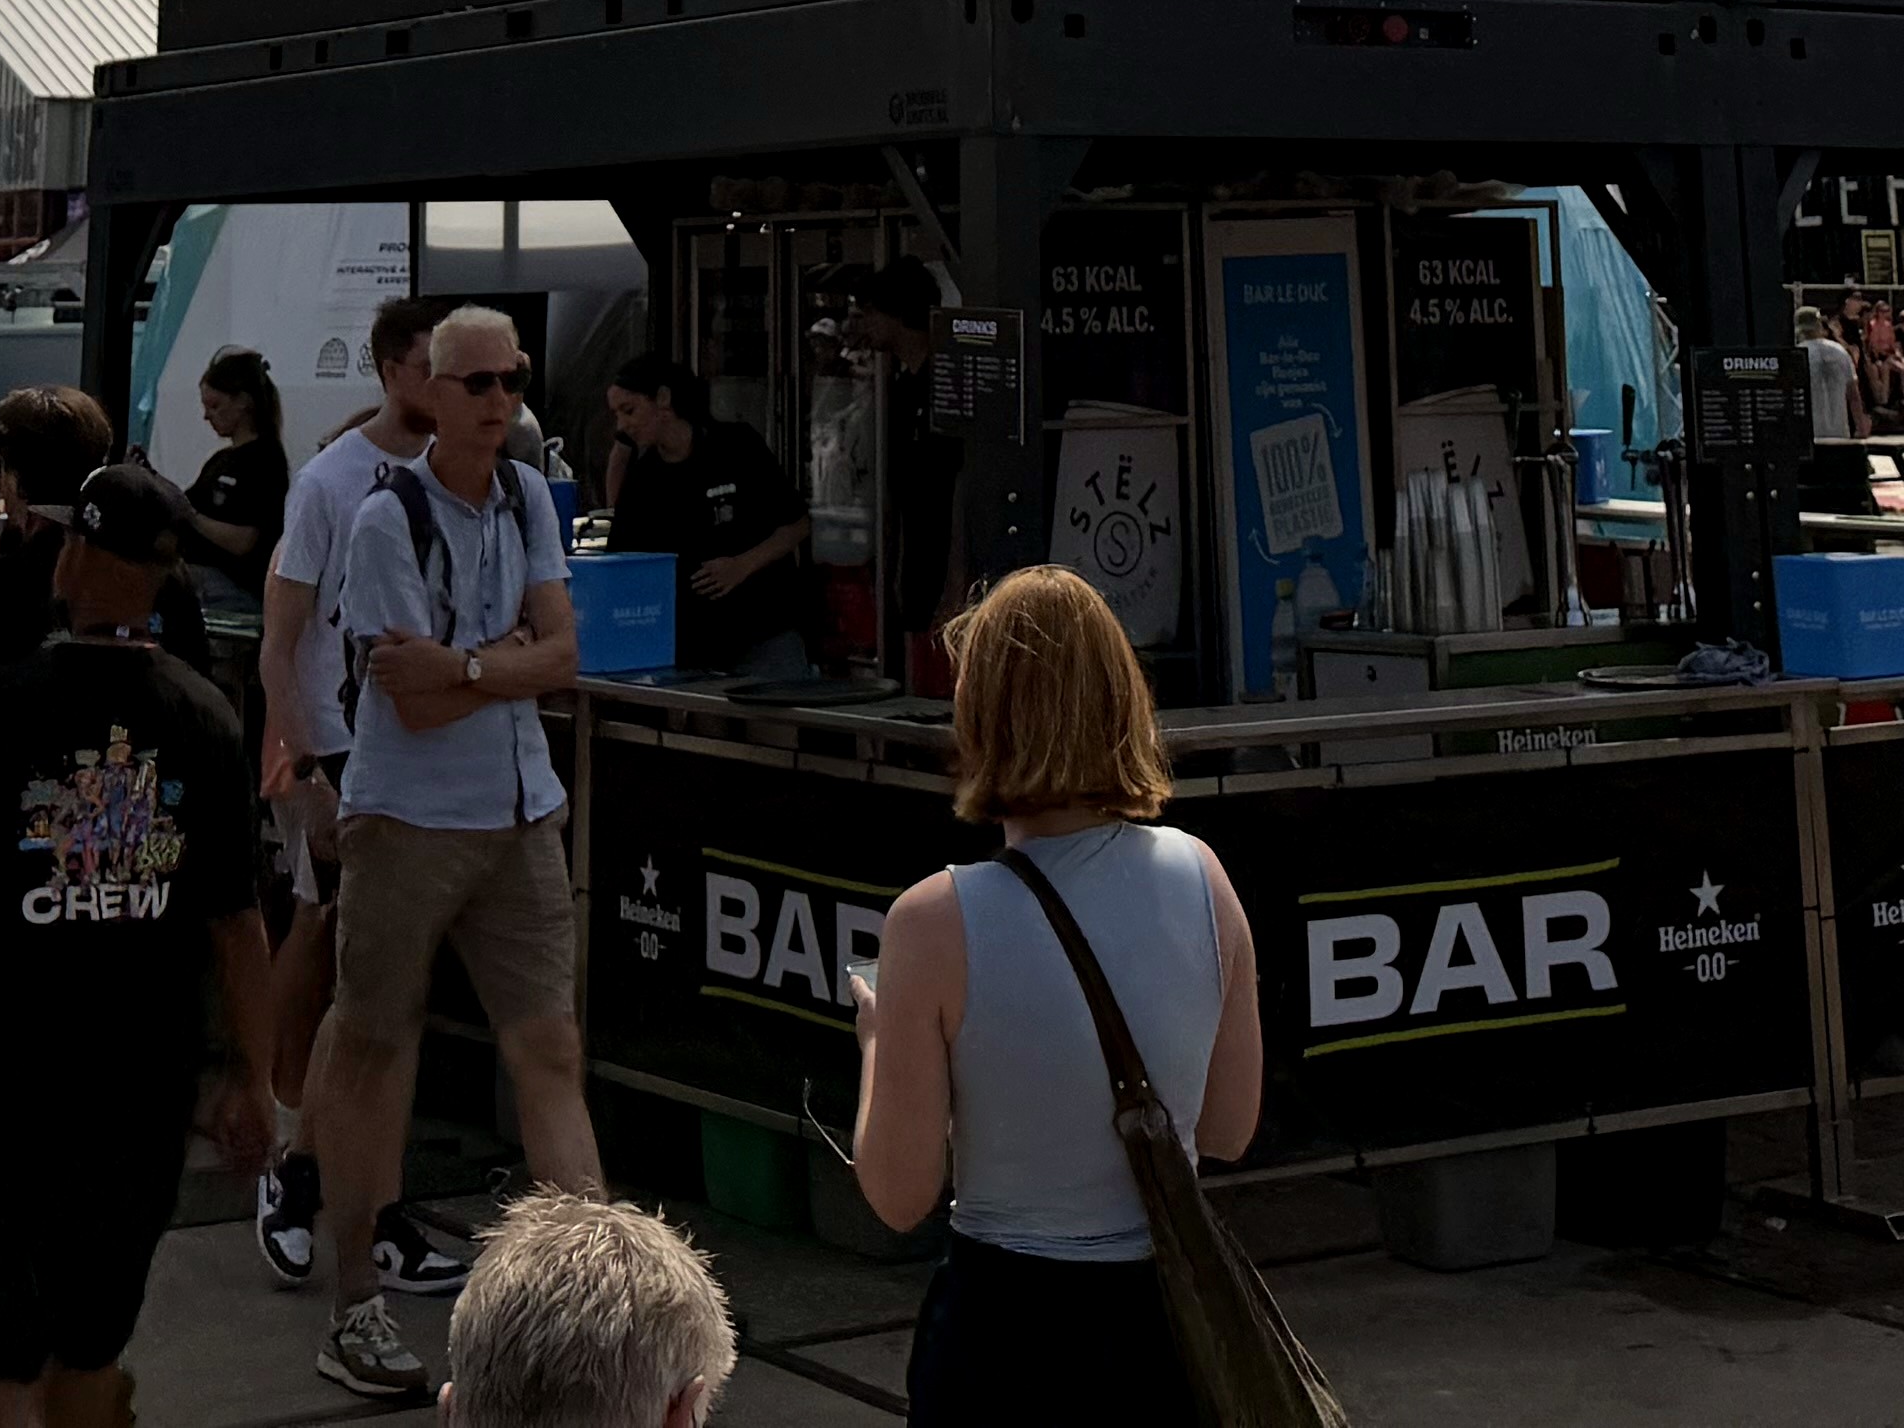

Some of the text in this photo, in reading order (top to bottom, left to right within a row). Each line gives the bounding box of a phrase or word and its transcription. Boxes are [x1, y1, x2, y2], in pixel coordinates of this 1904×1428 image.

[1052, 265, 1143, 293] 63 KCAL
[1419, 259, 1501, 286] 63 KCAL
[1040, 305, 1156, 335] 4.5 % ALC.
[1409, 297, 1514, 326] 4.5 % ALC.
[952, 318, 997, 335] DRINKS
[1722, 357, 1780, 371] DRINKS
[1261, 431, 1327, 498] 100%
[1497, 725, 1596, 753] Heineken
[619, 894, 682, 933] Heineken
[1658, 918, 1761, 952] Heineken
[1307, 889, 1619, 1028] BAR
